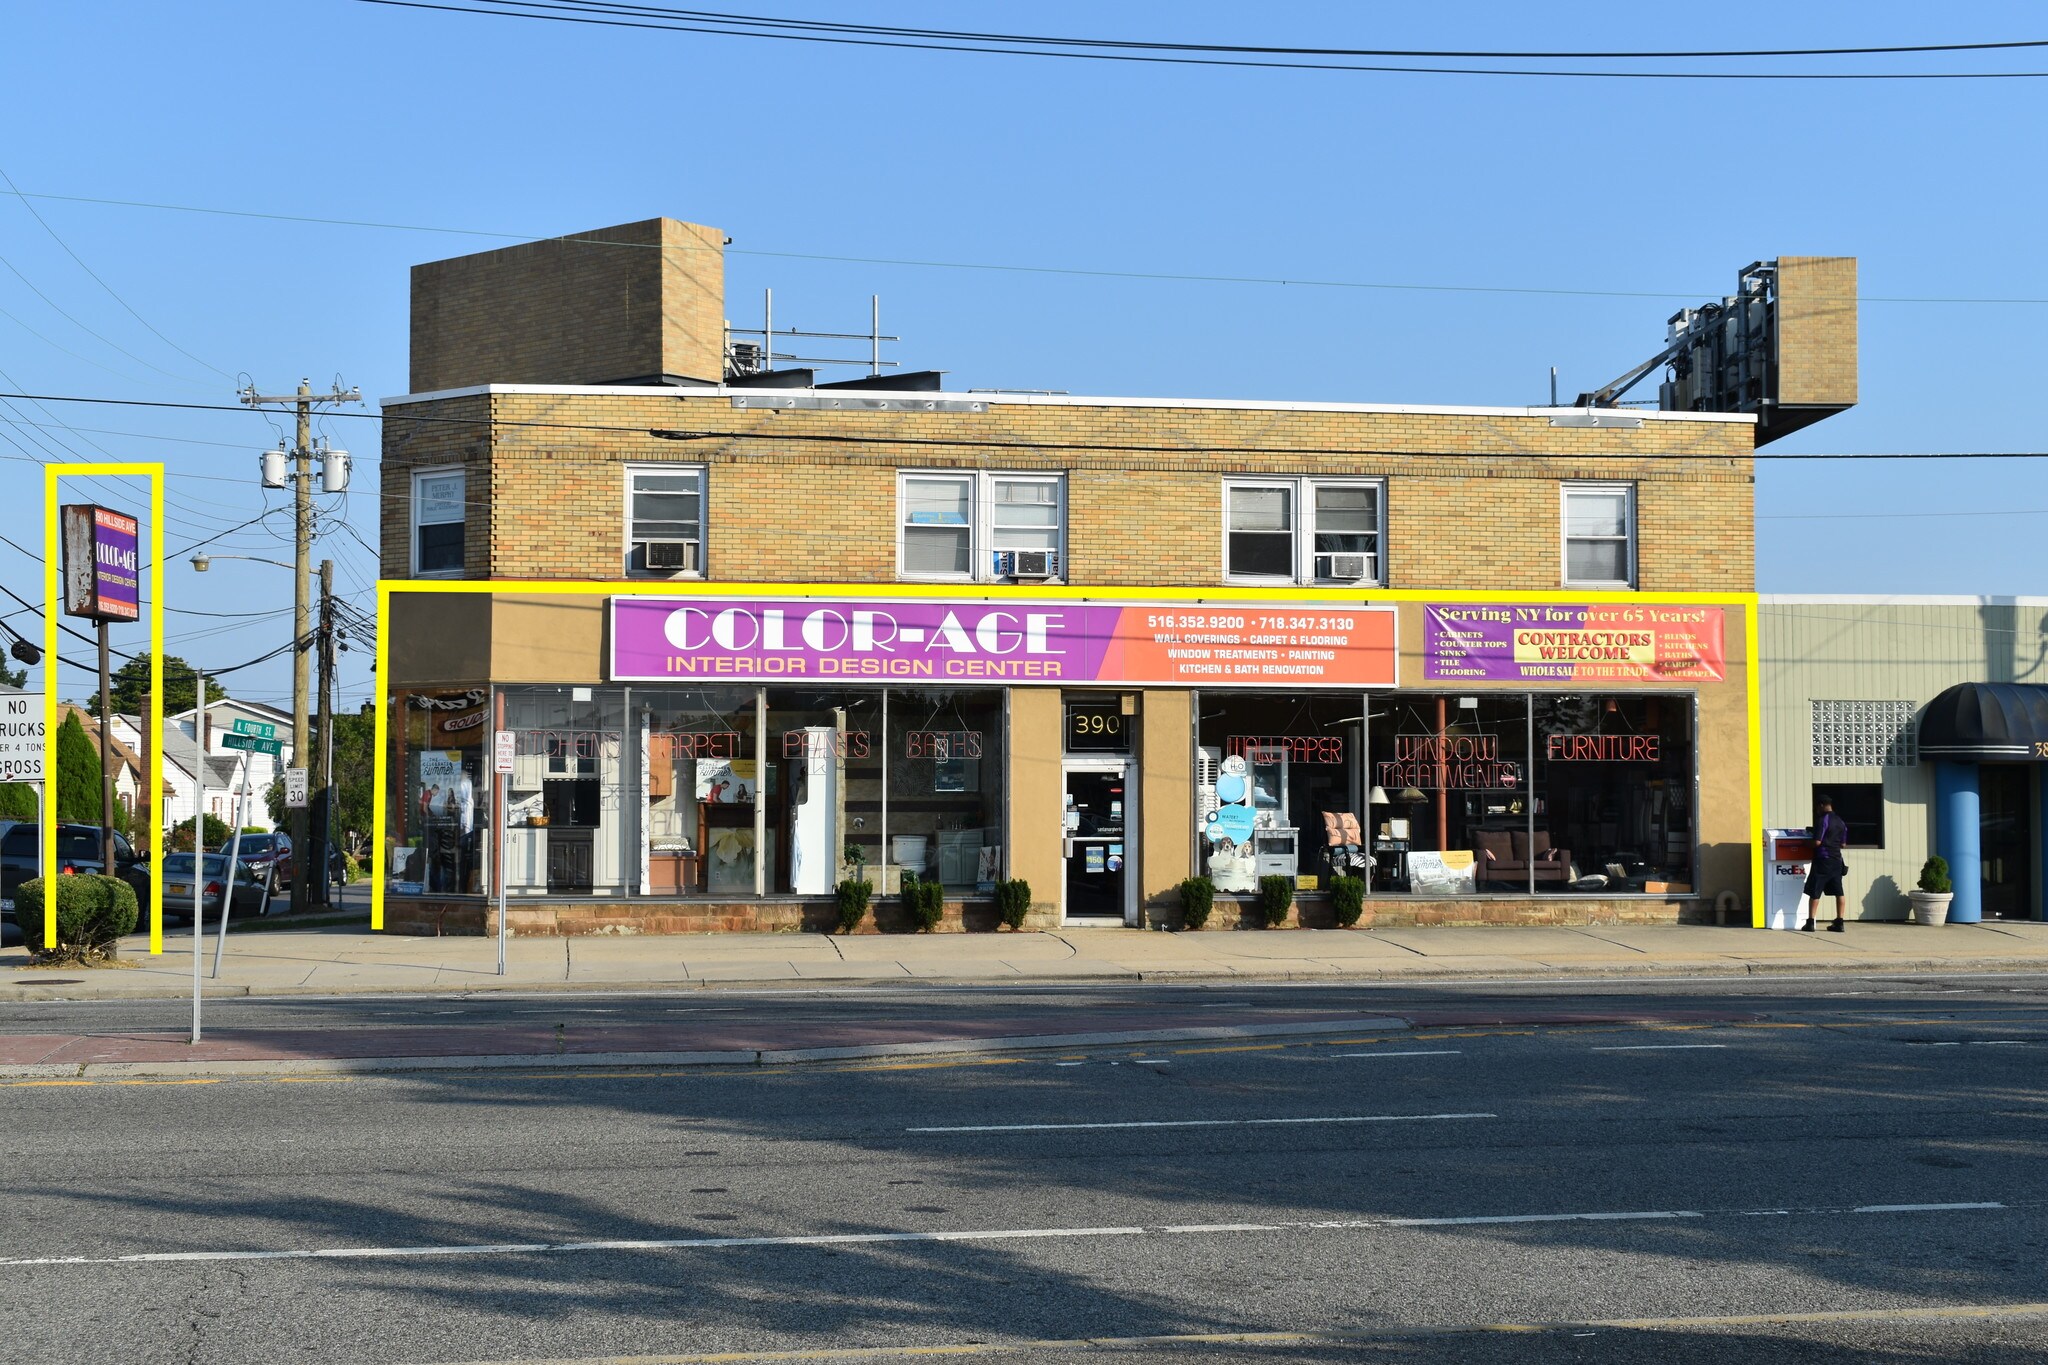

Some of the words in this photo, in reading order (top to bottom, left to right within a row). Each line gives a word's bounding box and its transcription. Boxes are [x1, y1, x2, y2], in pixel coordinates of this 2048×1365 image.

[103, 514, 126, 531] HILLSIDE
[96, 541, 137, 572] COLOR-AGE
[1000, 552, 1008, 575] Sale
[111, 574, 125, 586] DESIGN
[124, 578, 137, 589] CENTER
[1148, 615, 1245, 629] 516.352.9200
[1259, 616, 1354, 630] 718.347.3130
[1439, 607, 1511, 624] Serving
[1516, 608, 1541, 621] NY
[1545, 608, 1573, 622] for
[1576, 610, 1619, 622] over
[1623, 609, 1644, 622] 65
[1649, 609, 1706, 623] Years!
[664, 607, 1066, 654] COLOR-AGE
[1154, 633, 1182, 643] WALL
[1184, 634, 1241, 644] COVERINGS
[1250, 635, 1287, 645] CARPET
[1290, 635, 1297, 645] &
[1300, 635, 1348, 645] FLOORING
[1518, 632, 1651, 646] CONTRACTORS
[1168, 649, 1211, 659] WINDOW
[1214, 649, 1278, 659] TREATMENTS
[1289, 650, 1335, 660] PAINTING
[1539, 646, 1630, 660] WELCOME
[667, 656, 806, 673] INTERIOR
[819, 658, 933, 675] DESIGN
[945, 659, 1062, 676] CENTER
[1179, 664, 1222, 674] KITCHEN
[1225, 664, 1232, 674] &
[1234, 664, 1260, 674] BATH
[1262, 665, 1324, 675] RENOVATION
[1520, 666, 1555, 676] WHOLE
[1556, 666, 1578, 676] SALE
[1579, 666, 1594, 676] TO
[1596, 666, 1615, 677] THE
[1617, 666, 1649, 677] TRADE
[8, 700, 27, 714] NO
[244, 724, 262, 734] FOURTH
[1076, 715, 1120, 734] 390
[227, 737, 256, 749] HILLSIDE
[261, 741, 276, 752] AVE.
[501, 734, 509, 742] NO
[784, 732, 869, 758] PAINTS
[908, 732, 981, 758] BATHS
[15, 743, 20, 752] 4
[649, 733, 738, 759] CARPET
[1228, 736, 1342, 763] WALLPAPER
[1395, 736, 1496, 761] WINDOW
[1549, 735, 1659, 761] FURNITURE
[1380, 763, 1516, 788] TREATMENTS
[289, 790, 304, 802] 30
[1776, 865, 1806, 875] FedEx
